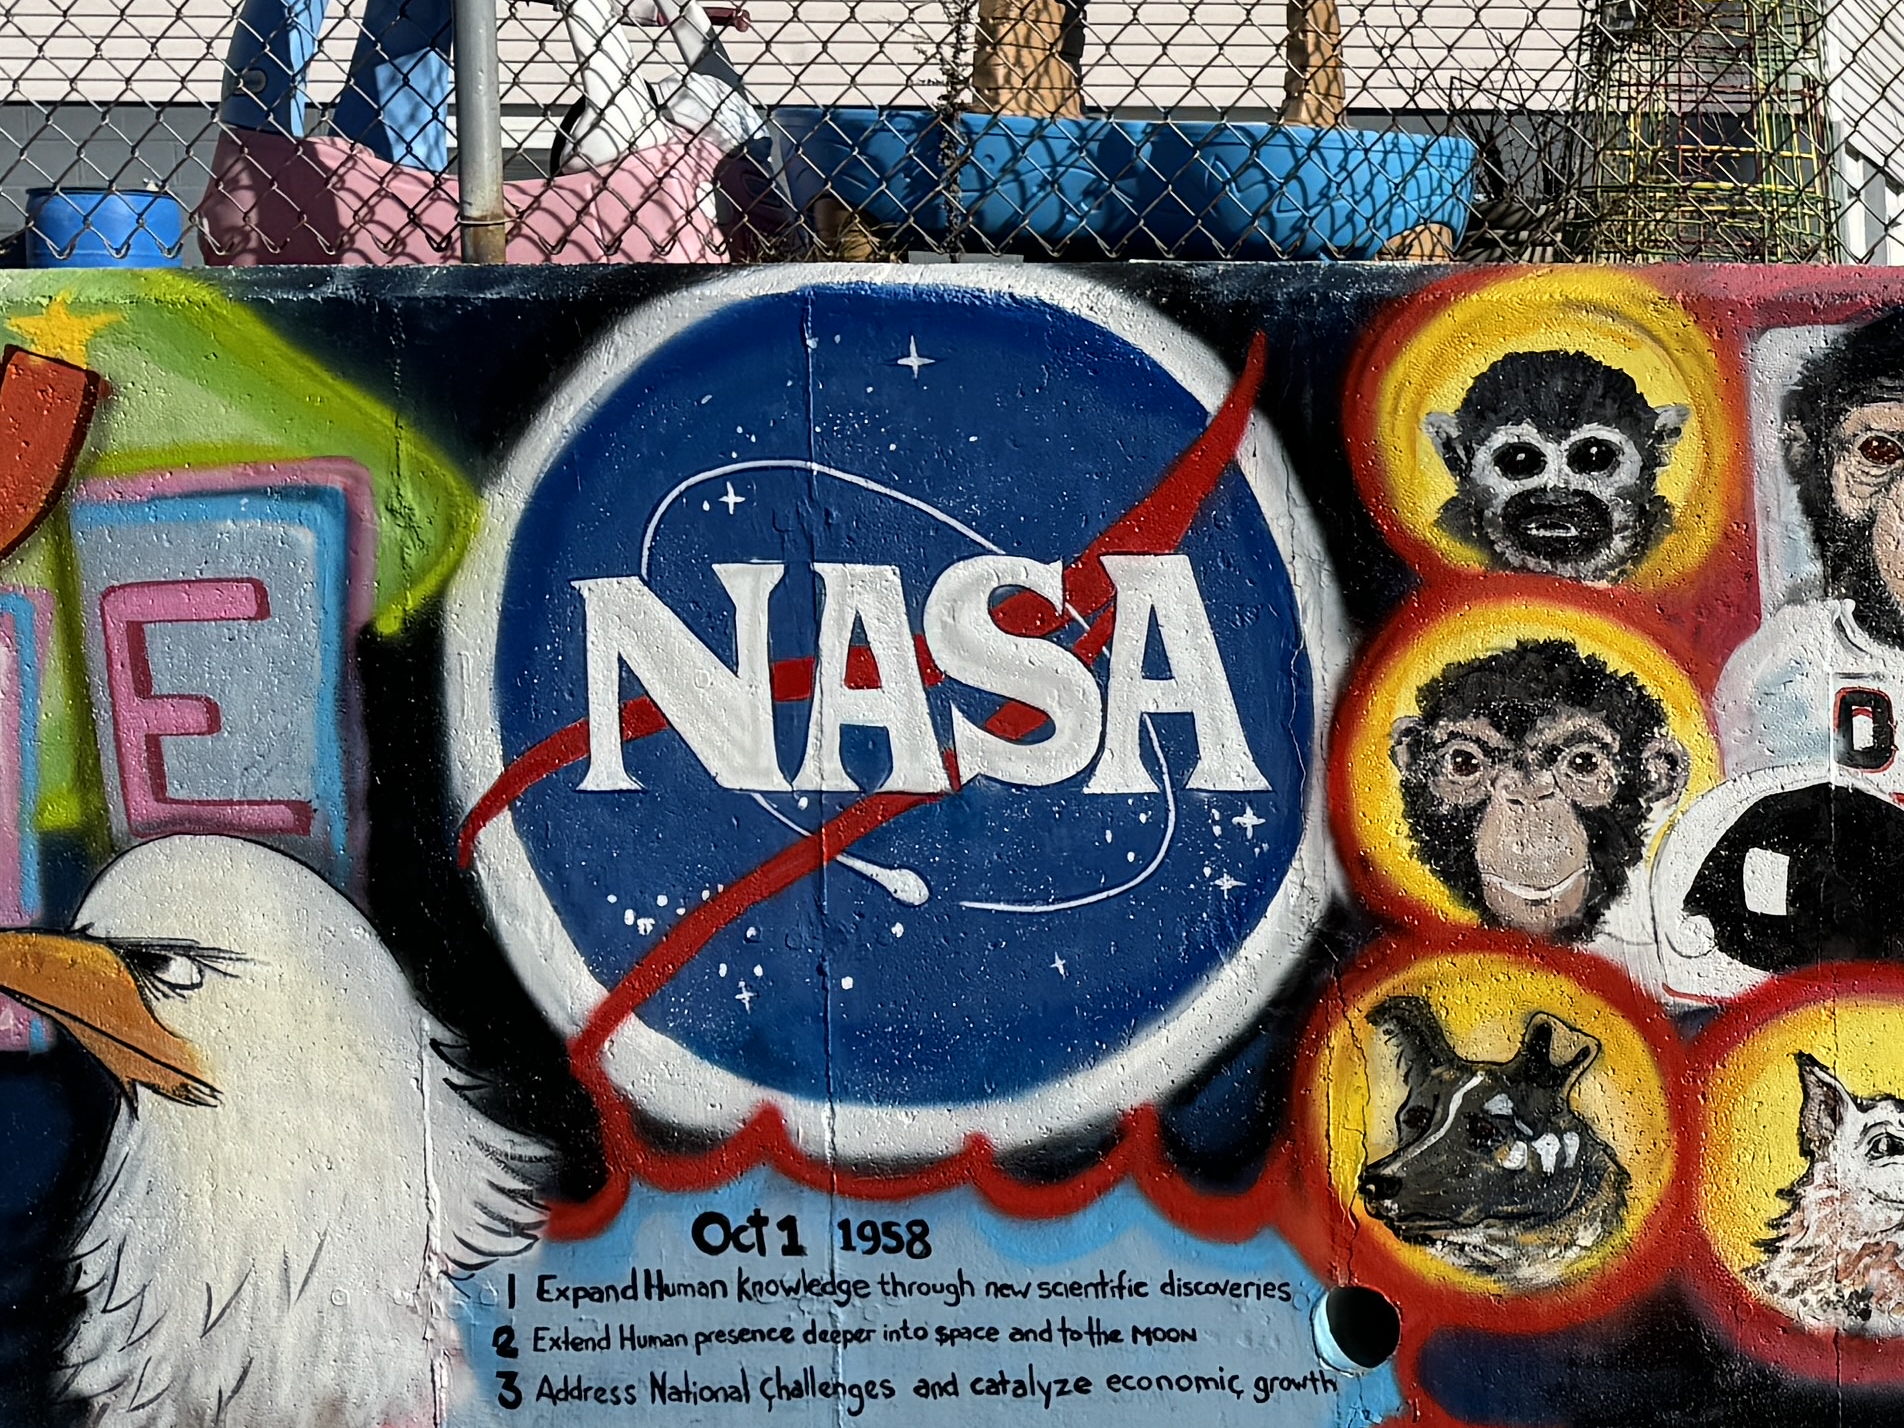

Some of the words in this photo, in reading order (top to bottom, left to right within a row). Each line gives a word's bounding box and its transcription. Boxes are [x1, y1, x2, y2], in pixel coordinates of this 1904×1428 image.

[569, 552, 1273, 793] NASA
[100, 578, 313, 837] E
[691, 1208, 769, 1257] Oct
[777, 1214, 808, 1256] 1
[837, 1217, 932, 1260] 1958
[507, 1274, 515, 1309] 1
[537, 1267, 638, 1309] Expand
[643, 1268, 728, 1302] Human
[737, 1267, 871, 1308] knowledge
[878, 1268, 975, 1307] through
[985, 1281, 1032, 1298] new
[1038, 1269, 1149, 1300] scientific
[1160, 1269, 1292, 1302] discoveries
[492, 1324, 519, 1359] 2
[532, 1323, 612, 1353] Extend
[619, 1323, 688, 1351] Human
[695, 1323, 795, 1356] presence
[803, 1318, 876, 1350] deeper
[883, 1318, 929, 1342] into
[935, 1325, 1000, 1347] space
[1009, 1318, 1053, 1343] and
[1058, 1315, 1083, 1347] to
[1083, 1315, 1124, 1348] the
[1131, 1324, 1198, 1346] MOON
[495, 1370, 523, 1410] 3
[535, 1374, 637, 1406] Address
[650, 1367, 750, 1406] National
[913, 1372, 959, 1400] and
[970, 1363, 1093, 1409] catalyze
[1106, 1366, 1244, 1400] economic
[1253, 1370, 1338, 1404] growth
